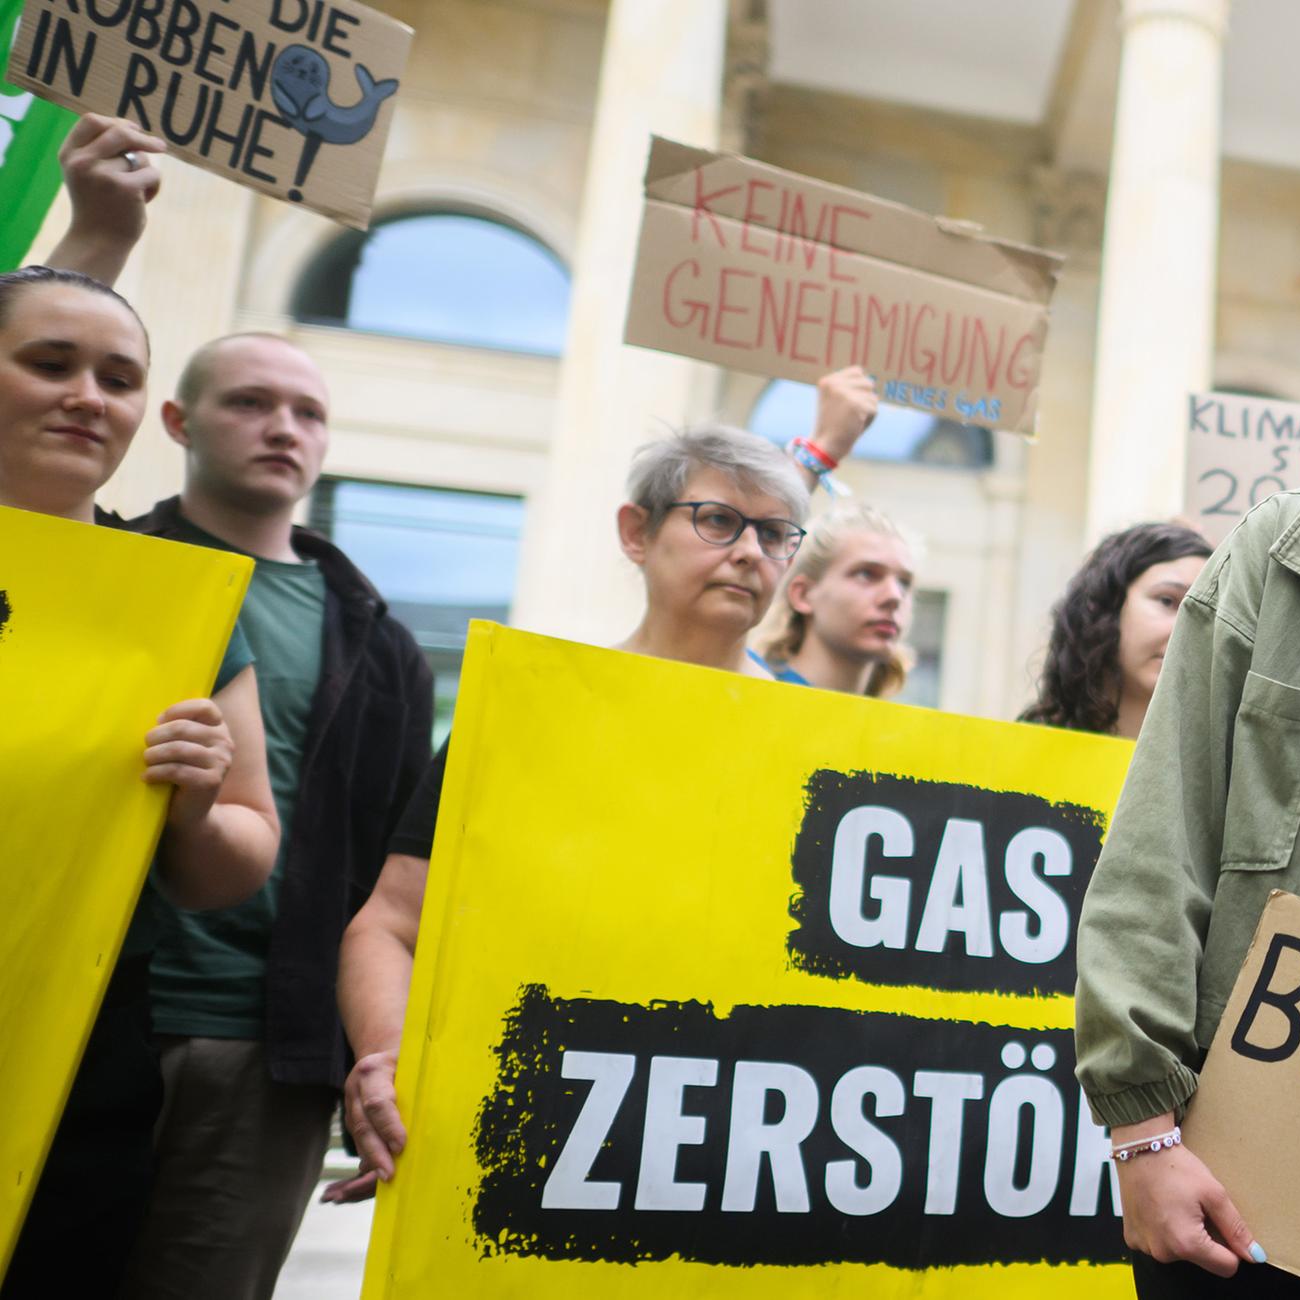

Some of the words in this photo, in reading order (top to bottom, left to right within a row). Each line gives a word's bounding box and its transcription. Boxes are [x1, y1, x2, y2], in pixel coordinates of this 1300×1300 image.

[26, 9, 97, 98] IN
[269, 0, 361, 59] DIE
[117, 53, 322, 201] RUHE!
[690, 164, 872, 284] KEINE
[662, 259, 1036, 393] GENEHMIGUNG
[954, 391, 1003, 423] GAS
[828, 804, 1074, 965] GAS
